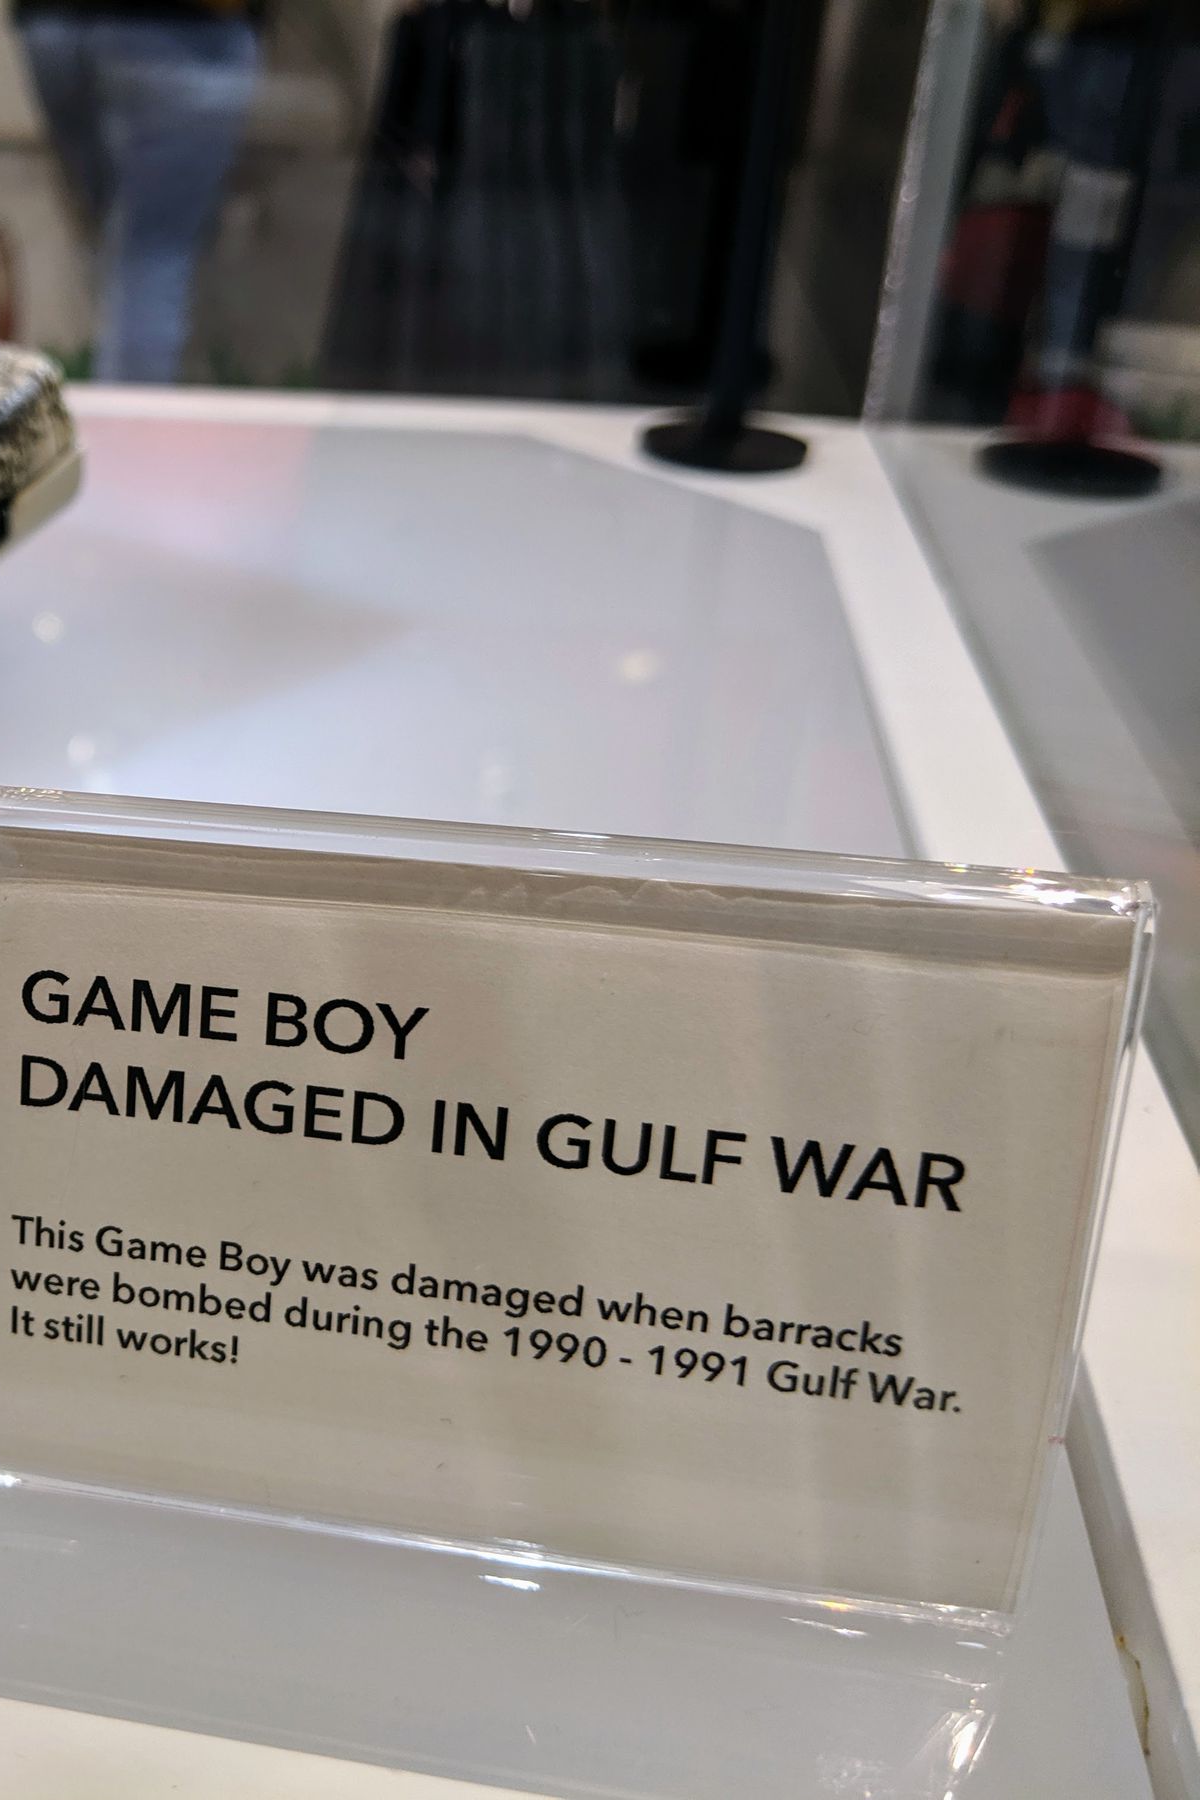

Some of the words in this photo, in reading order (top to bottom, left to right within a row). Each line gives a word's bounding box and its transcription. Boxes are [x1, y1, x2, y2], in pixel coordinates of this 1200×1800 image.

[22, 970, 238, 1042] GAME
[266, 992, 430, 1060] BOY
[20, 1055, 405, 1145] DAMAGED
[432, 1100, 509, 1161] IN
[537, 1113, 747, 1185] GULF
[771, 1136, 965, 1212] WAR
[11, 1215, 84, 1252] This
[96, 1226, 206, 1268] Game
[220, 1241, 291, 1286] Boy
[302, 1261, 378, 1290] was
[391, 1263, 584, 1318] damaged
[597, 1292, 709, 1333] when
[723, 1303, 903, 1357] barracks
[11, 1306, 34, 1337] It
[44, 1314, 104, 1346] still
[117, 1329, 238, 1364] works!
[11, 1269, 100, 1300] were
[113, 1272, 271, 1323] bombed
[284, 1297, 411, 1350] during
[425, 1316, 488, 1352] the
[504, 1327, 607, 1368] 1990
[648, 1346, 747, 1386] 1991
[767, 1361, 859, 1399] Gulf
[868, 1372, 960, 1412] War.
